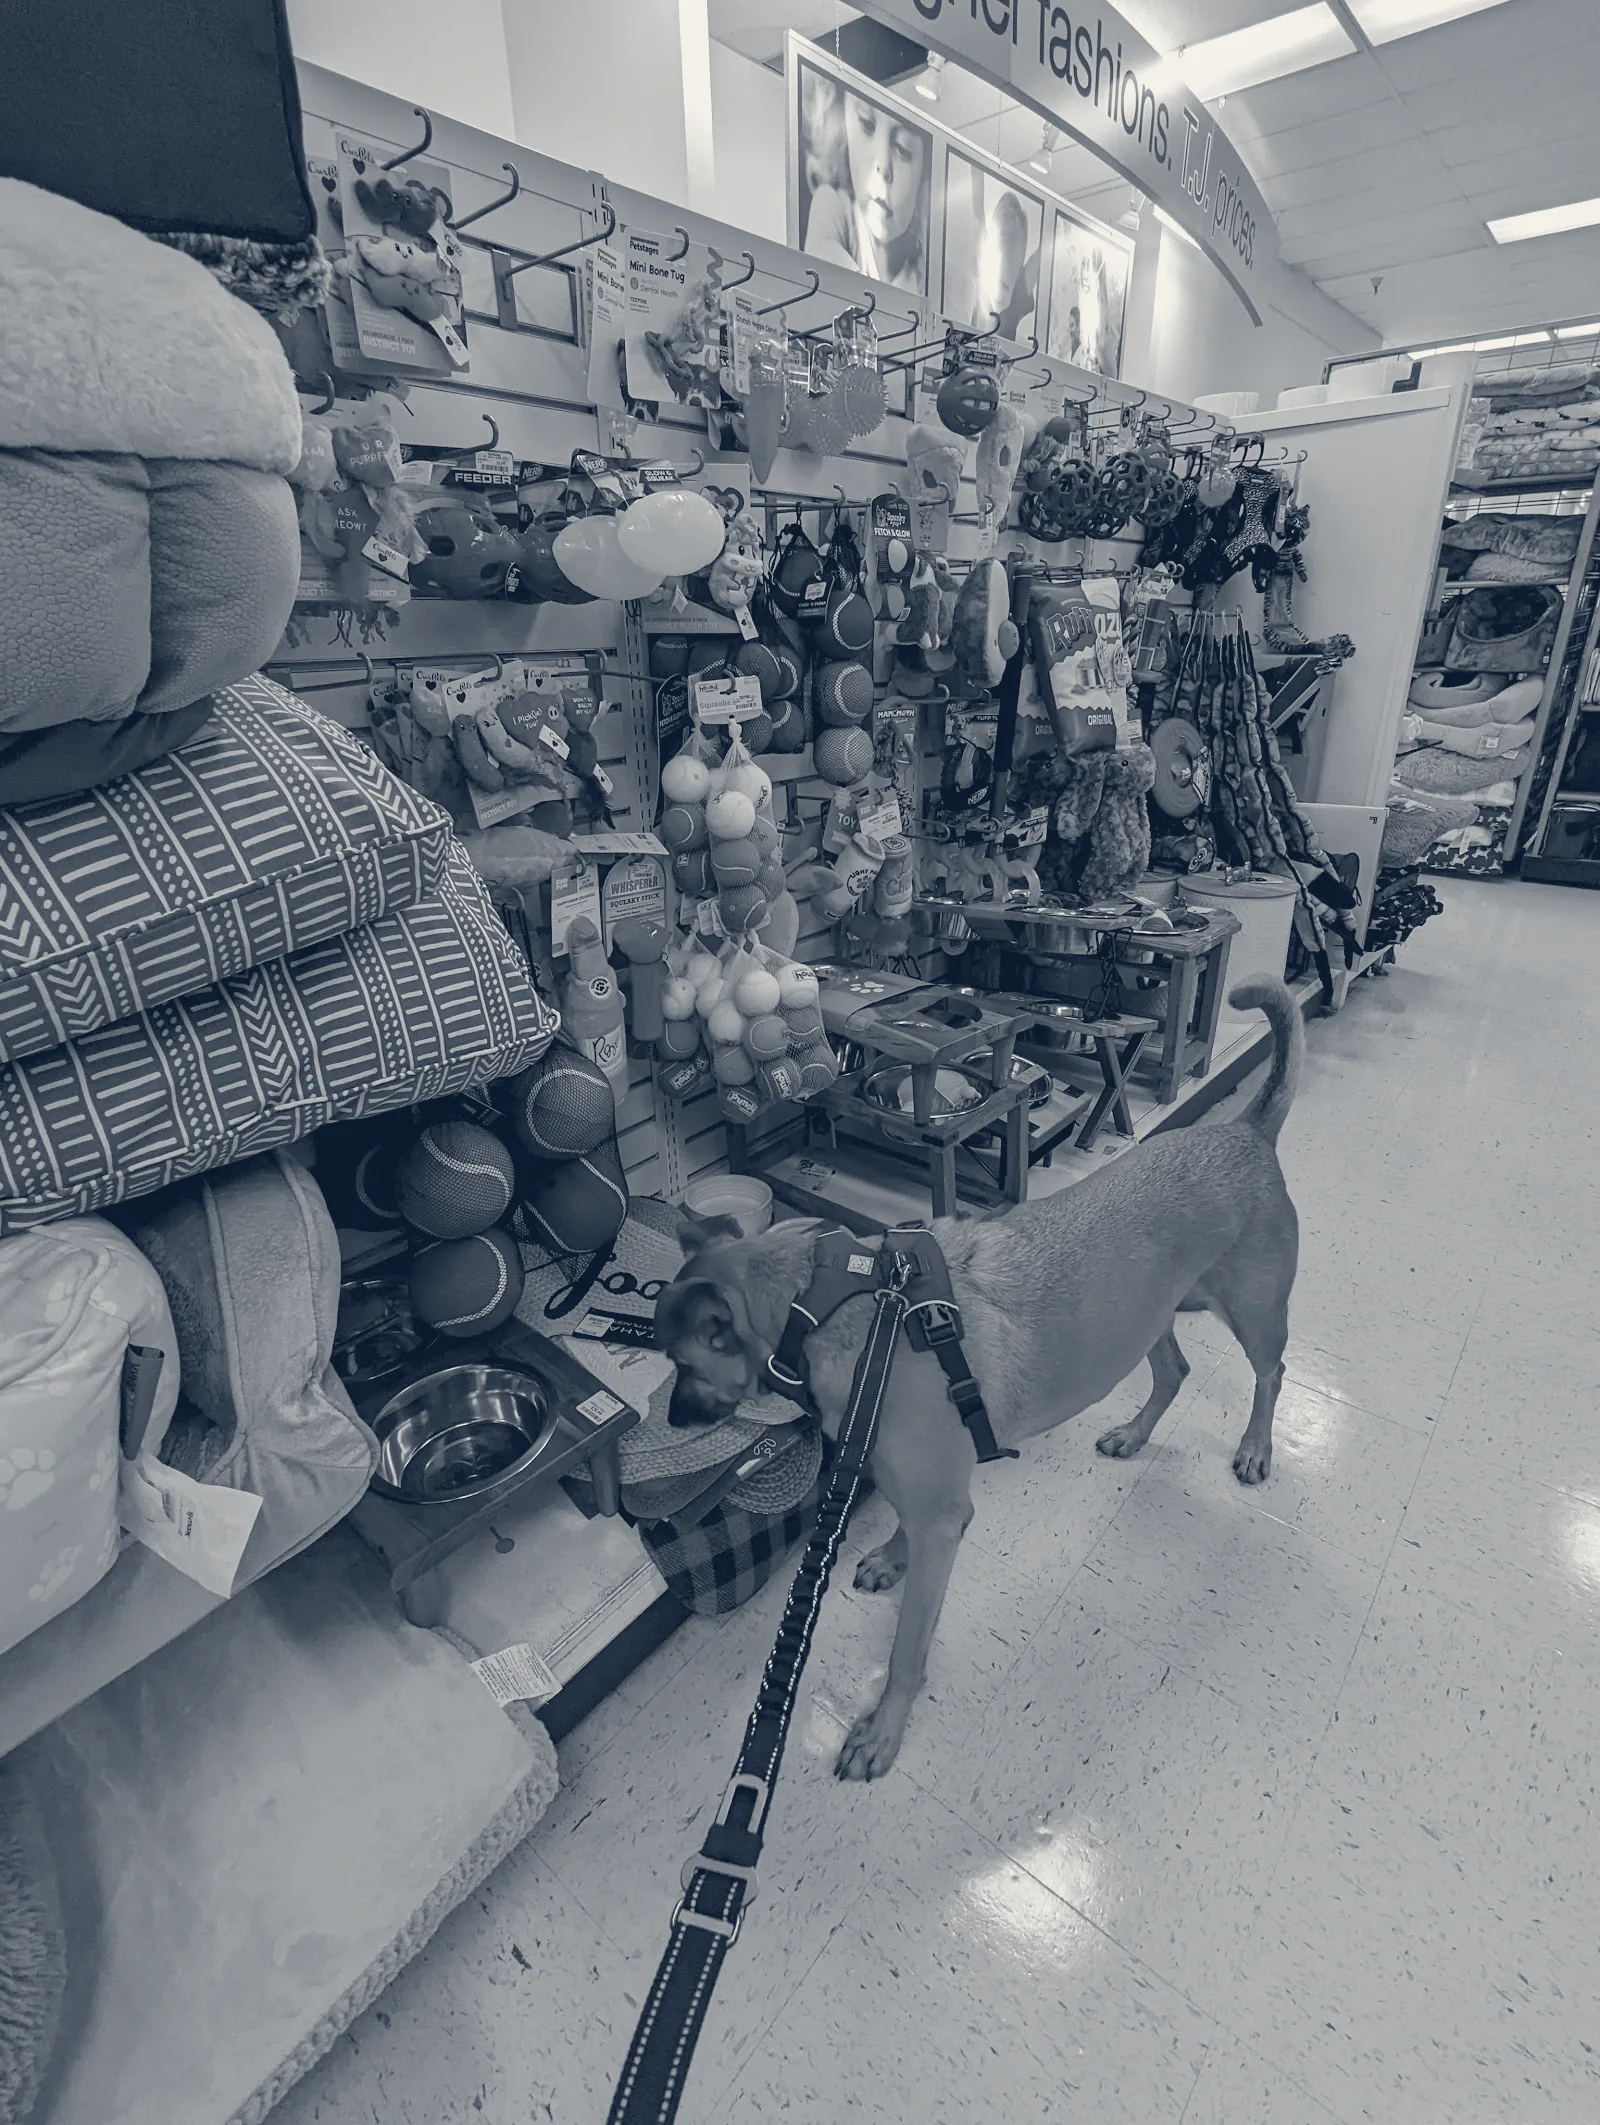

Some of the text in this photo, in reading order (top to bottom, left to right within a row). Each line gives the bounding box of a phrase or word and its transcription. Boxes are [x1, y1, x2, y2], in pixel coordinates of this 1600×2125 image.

[1211, 170, 1256, 270] prices.
[629, 240, 658, 255] Petstages
[629, 260, 685, 284] Mini Bone Tug
[597, 270, 609, 284] Mini
[610, 277, 625, 293] Bone
[584, 458, 606, 471] NERF
[455, 472, 512, 485] FEEDER
[522, 466, 542, 479] NERF
[874, 527, 891, 536] FETCH
[895, 529, 911, 537] GLOW
[1087, 714, 1113, 726] ORIGINAL
[480, 803, 506, 821] INSTINCT
[506, 800, 517, 809] TOY
[610, 875, 658, 896] WHISPERER
[610, 892, 660, 908] SQUEAKY STICK
